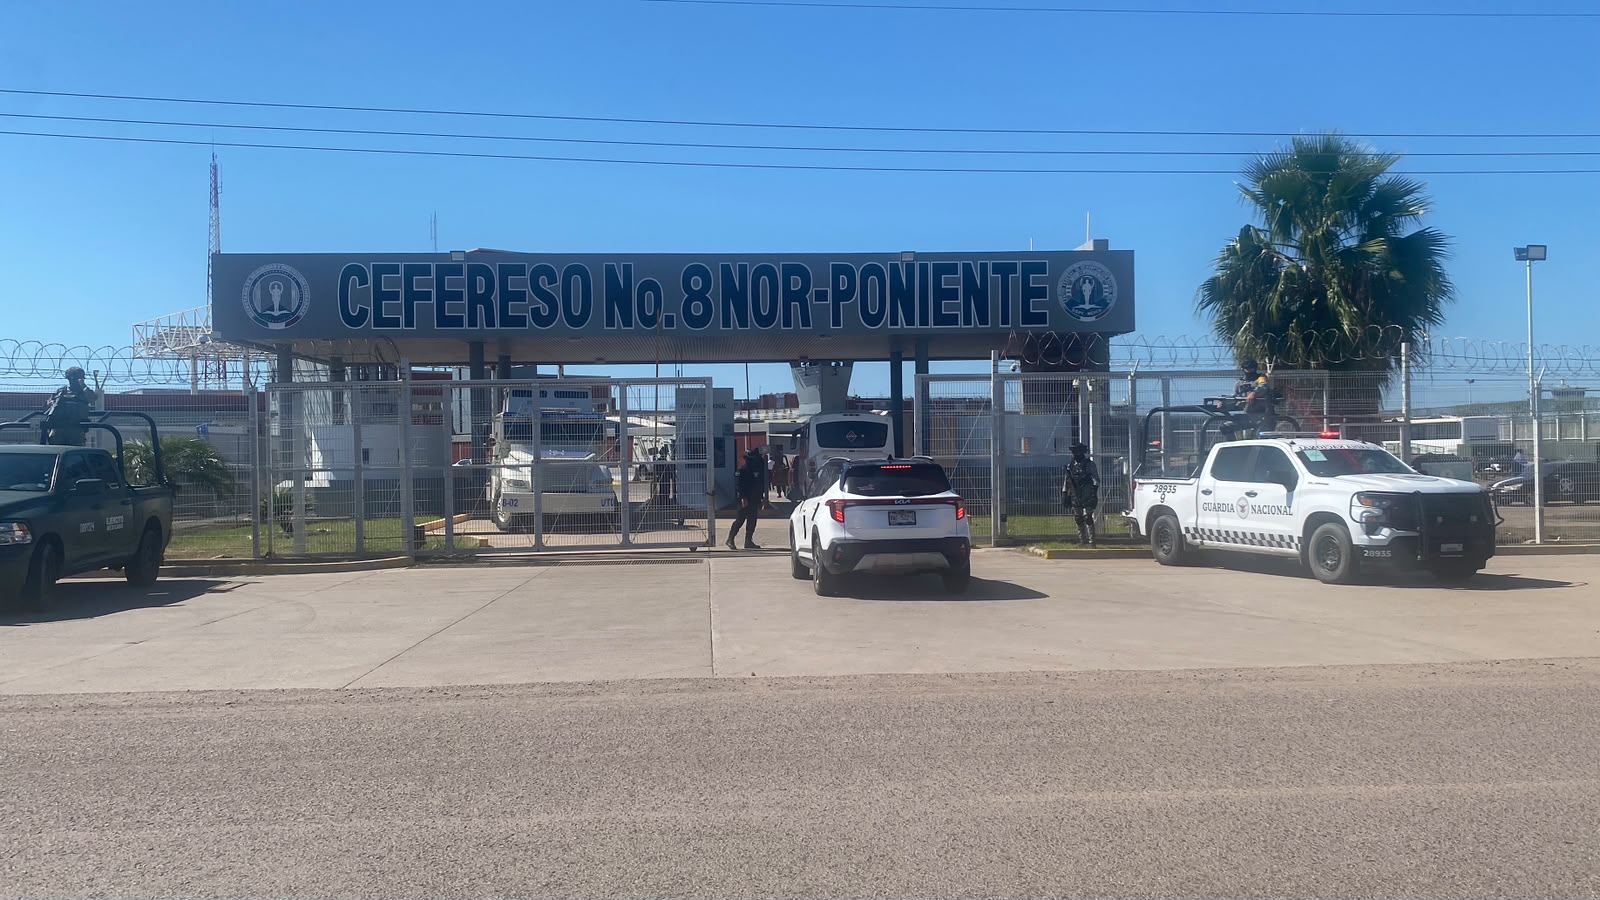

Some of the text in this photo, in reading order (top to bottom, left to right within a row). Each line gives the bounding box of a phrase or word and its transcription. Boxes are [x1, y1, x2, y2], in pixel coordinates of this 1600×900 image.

[338, 262, 594, 330] CEFERESO
[604, 262, 677, 330] No.
[680, 262, 714, 330] 8
[719, 260, 1049, 330] NOR-PONIENTE
[1153, 484, 1177, 493] 28935
[1160, 492, 1166, 503] 9
[1202, 502, 1293, 516] GUARDIA NACIONAL
